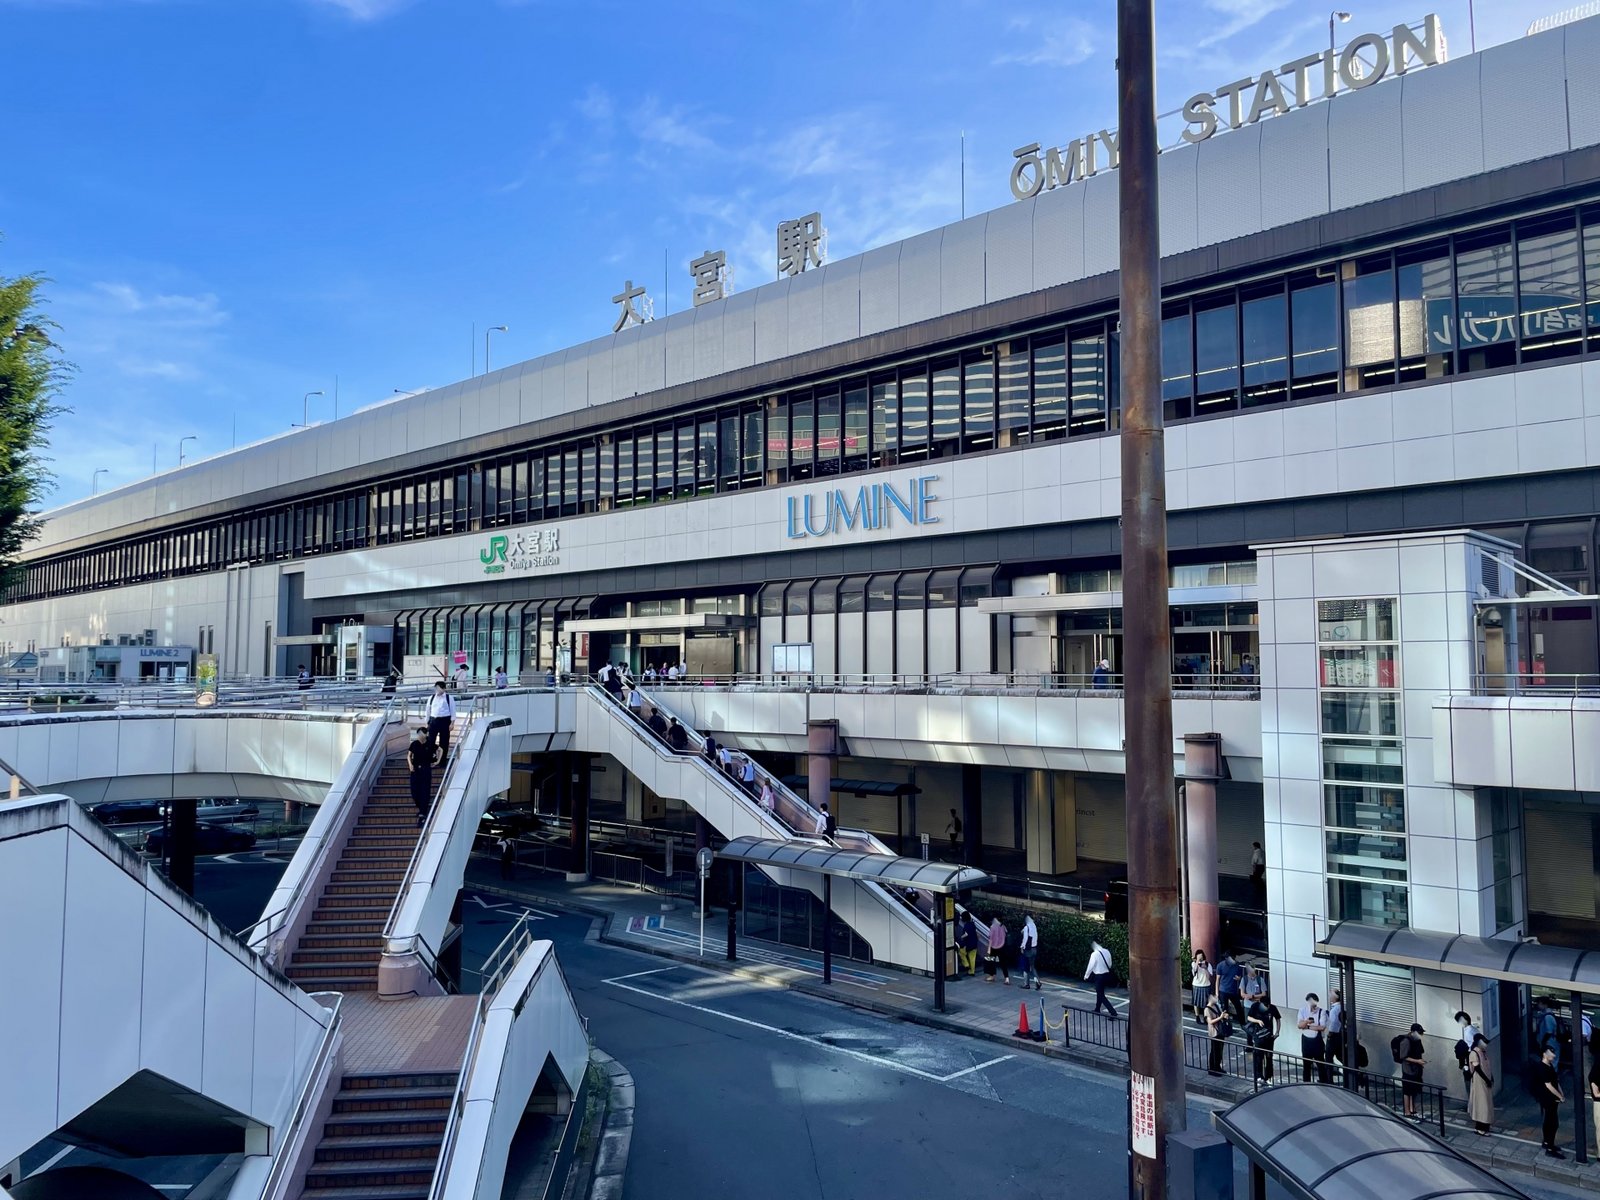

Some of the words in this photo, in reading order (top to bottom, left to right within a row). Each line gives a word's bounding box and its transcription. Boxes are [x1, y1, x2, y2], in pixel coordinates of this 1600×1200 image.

[1182, 14, 1441, 143] STATION
[612, 212, 822, 332] 大宮駅
[787, 475, 939, 539] LUMINE
[480, 535, 508, 564] JR
[511, 528, 559, 557] 大宮駅
[532, 555, 559, 567] Station
[140, 649, 172, 657] LUMINE
[173, 649, 180, 657] 2
